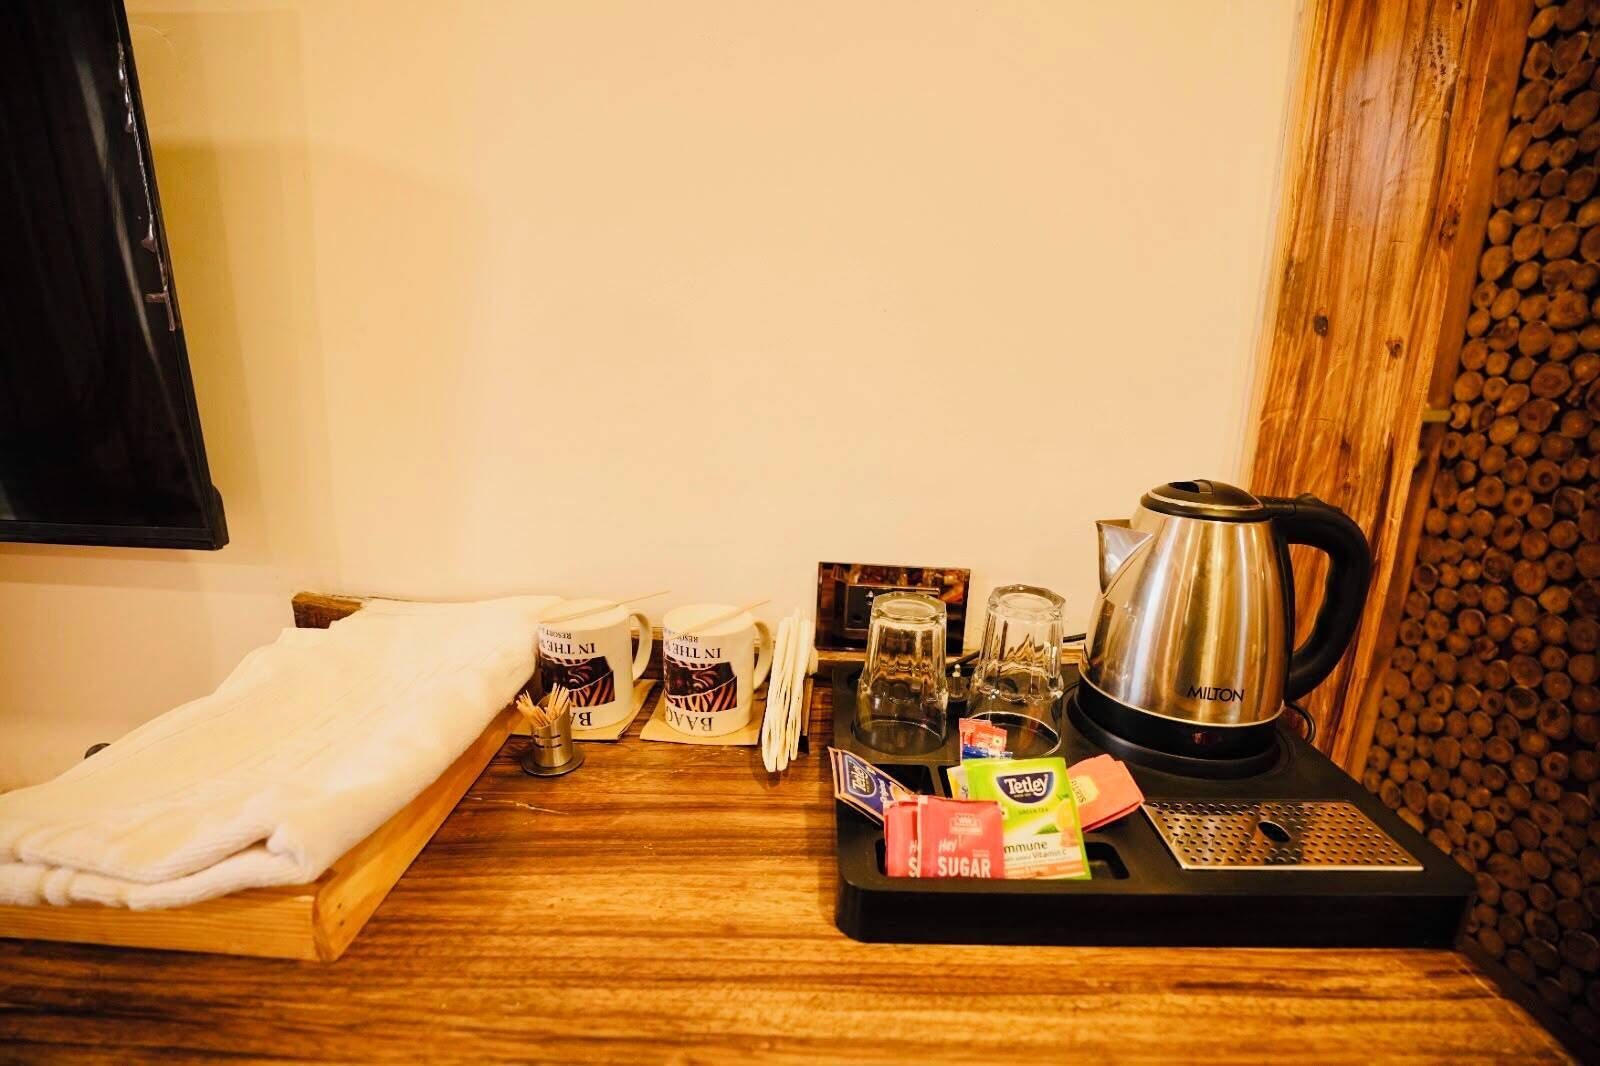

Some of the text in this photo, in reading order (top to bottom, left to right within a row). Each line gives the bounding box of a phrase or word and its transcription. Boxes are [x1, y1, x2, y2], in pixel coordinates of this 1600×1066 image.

[547, 640, 575, 655] THE
[580, 642, 596, 655] IN
[673, 642, 700, 659] THE
[705, 647, 721, 659] IN
[1187, 686, 1245, 703] MILTON
[1003, 773, 1049, 797] Tetley
[1003, 841, 1049, 854] mmune
[937, 855, 992, 878] SUGAR
